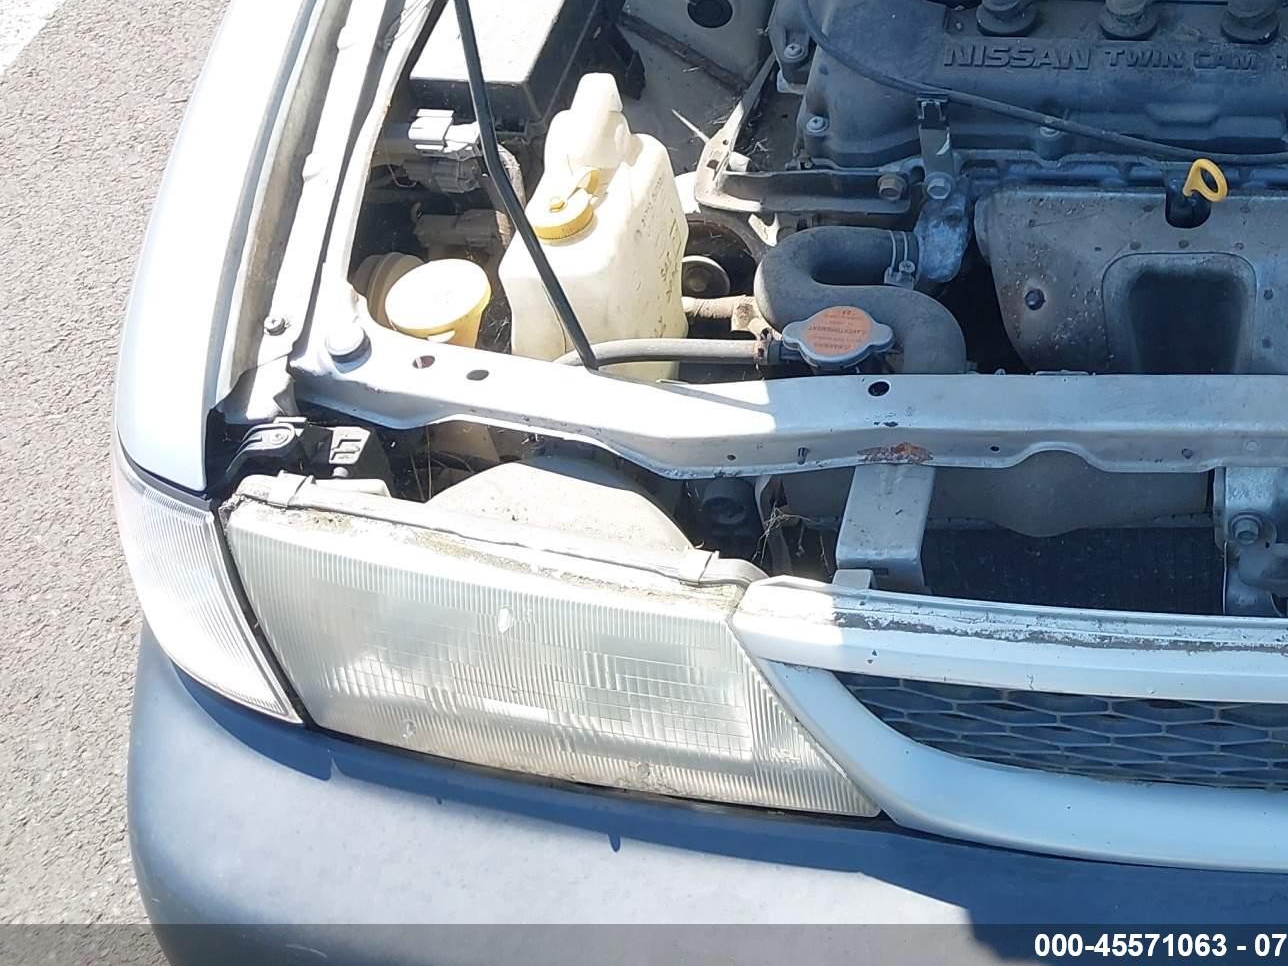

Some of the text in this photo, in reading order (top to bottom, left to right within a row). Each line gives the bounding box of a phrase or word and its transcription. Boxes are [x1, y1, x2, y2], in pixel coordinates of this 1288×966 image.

[943, 43, 1092, 70] NISSAN
[1104, 49, 1184, 69] TWIN
[1193, 52, 1259, 71] CAM
